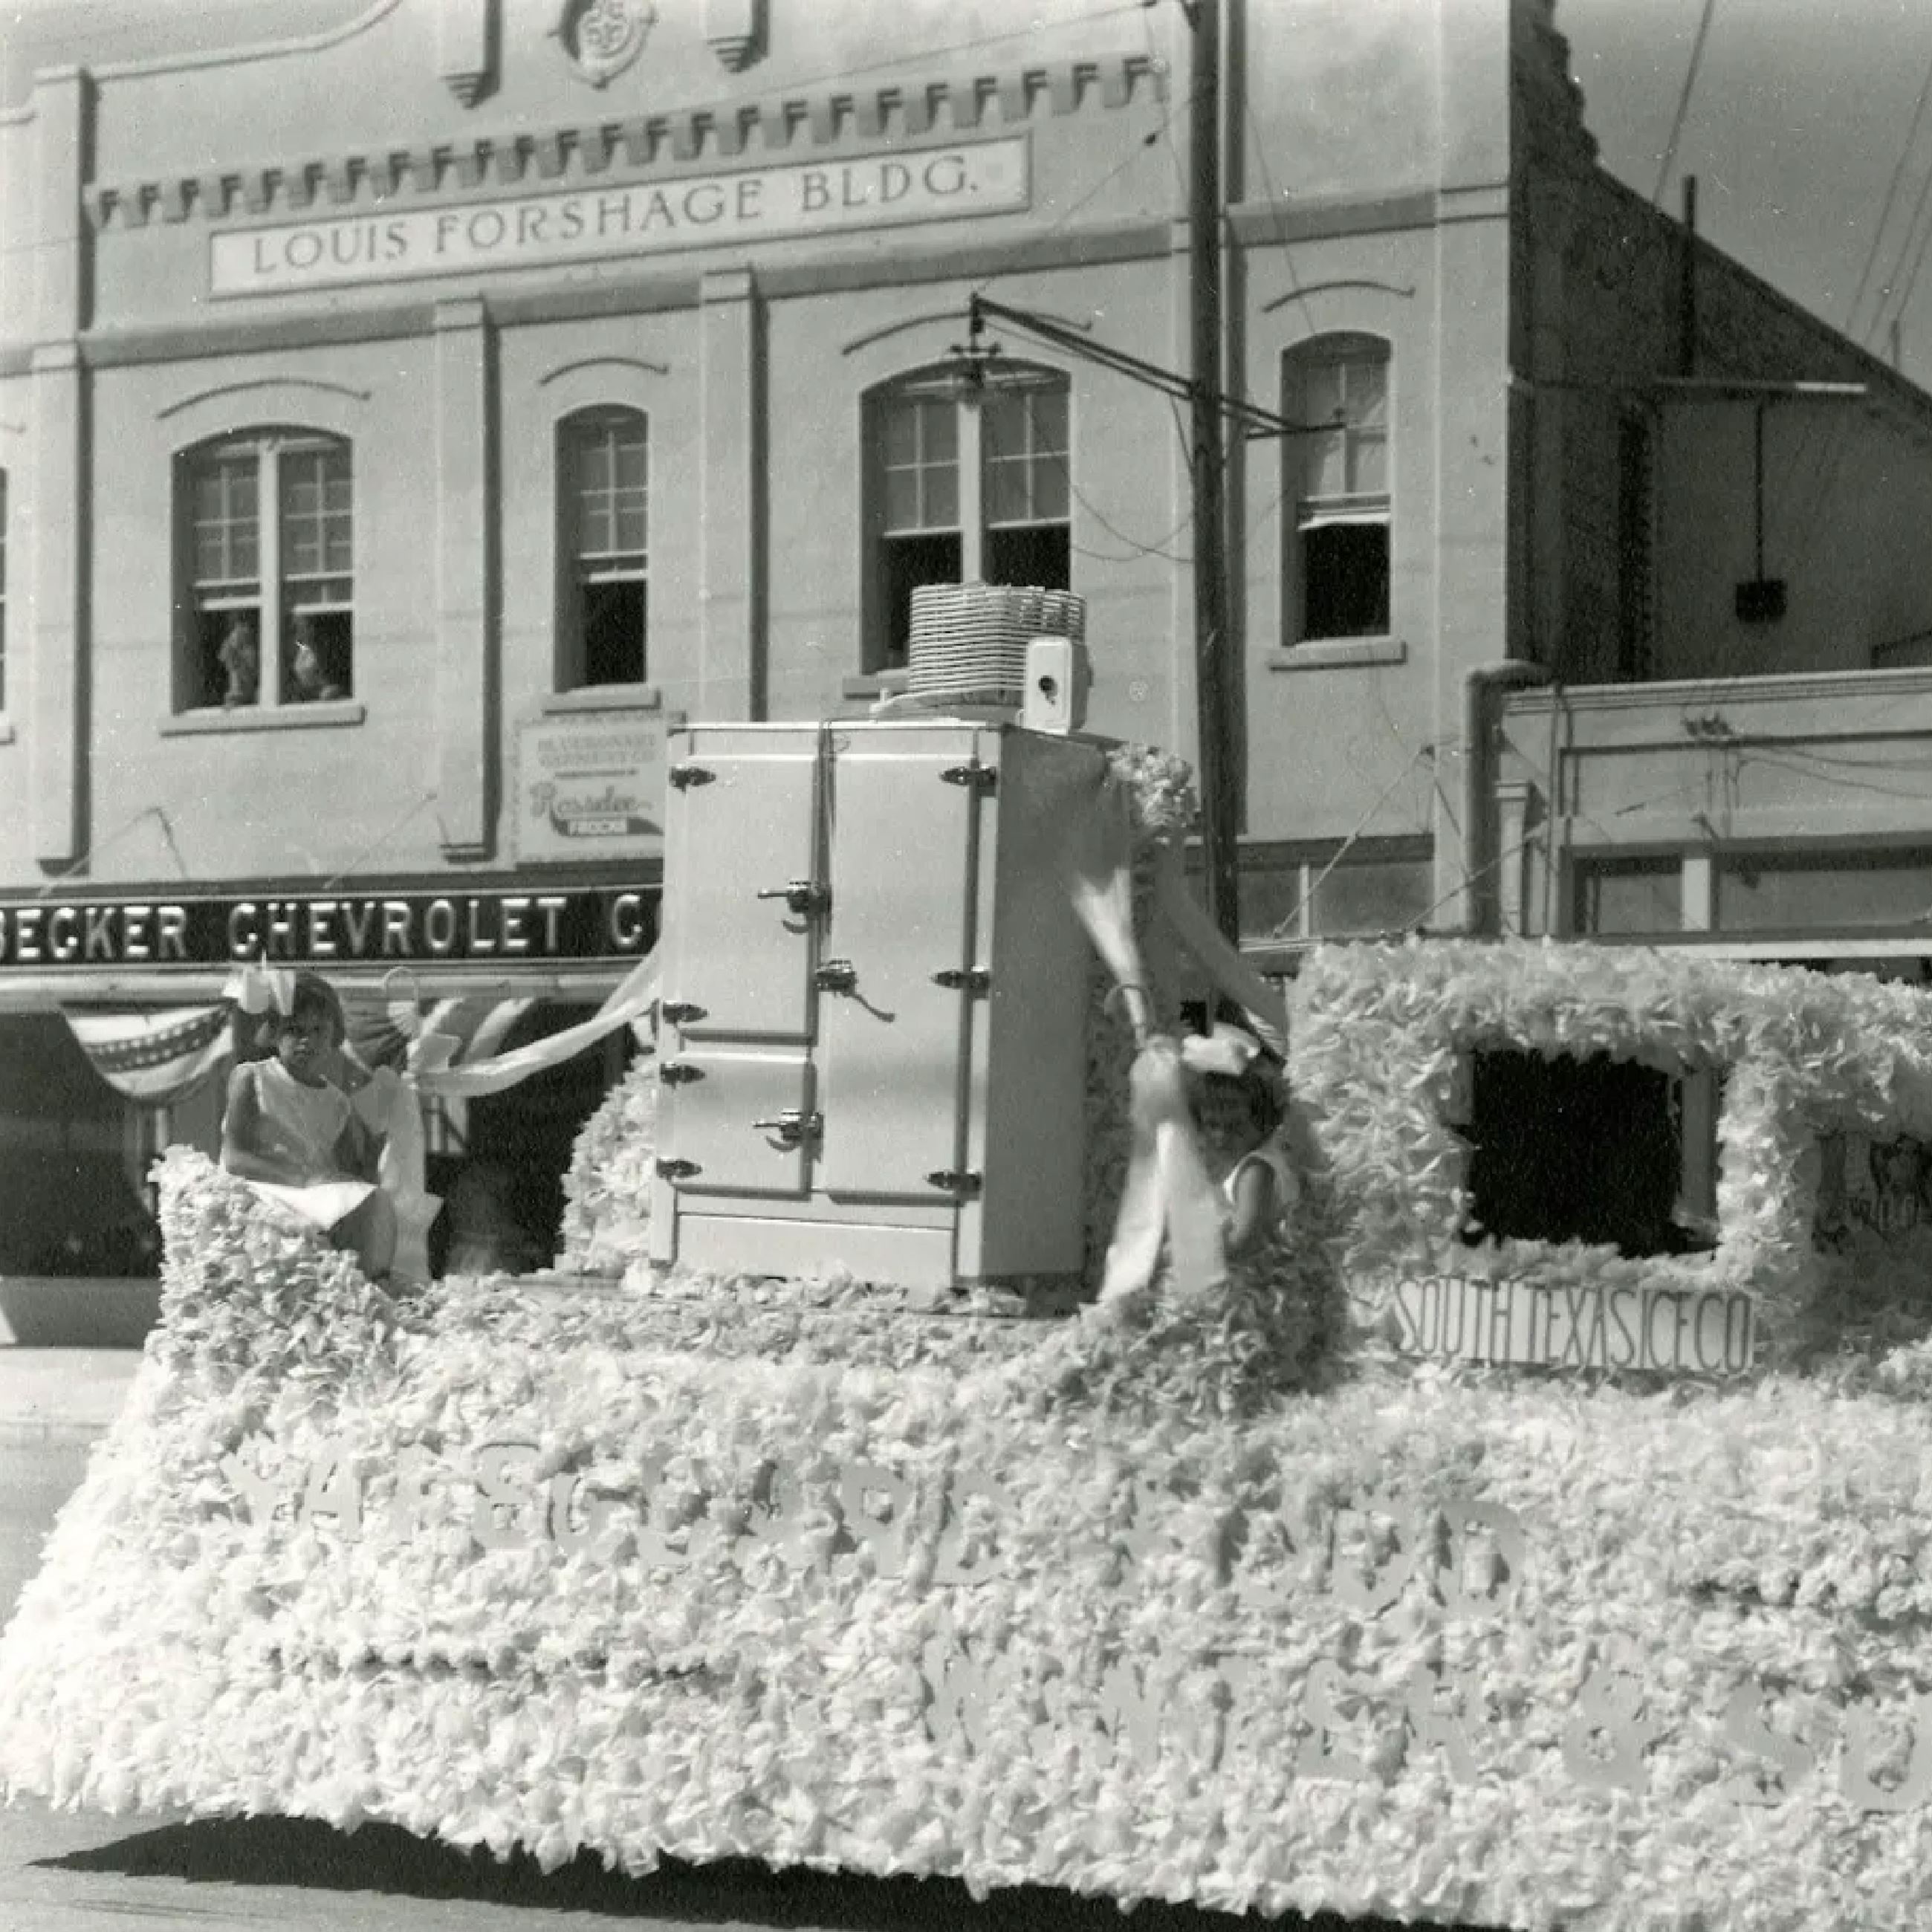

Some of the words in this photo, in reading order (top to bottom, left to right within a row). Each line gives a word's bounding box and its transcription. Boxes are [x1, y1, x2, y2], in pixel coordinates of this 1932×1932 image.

[254, 221, 408, 273] LOUIS
[435, 178, 763, 253] FORSHAGE
[802, 155, 979, 213] BLDG.
[0, 905, 187, 961] ECKER
[228, 895, 567, 956] CHEVROLET
[1395, 1275, 1514, 1364] SOUTH
[1522, 1280, 1636, 1371] TEXAS
